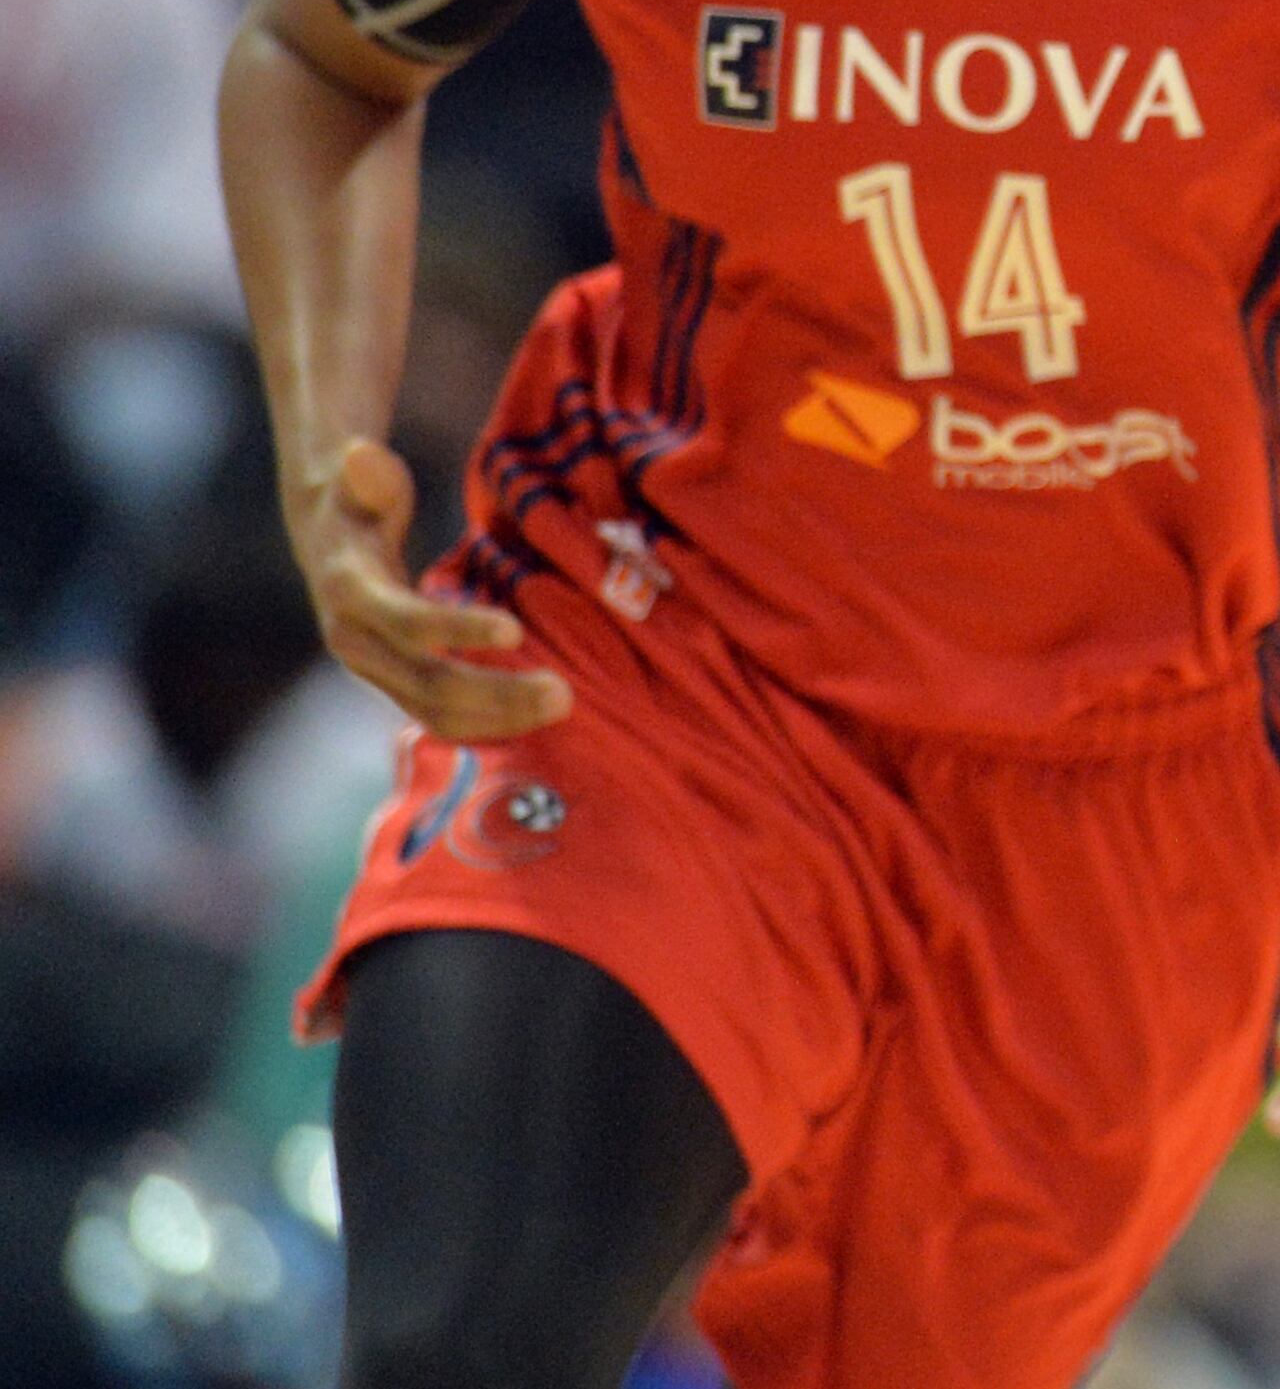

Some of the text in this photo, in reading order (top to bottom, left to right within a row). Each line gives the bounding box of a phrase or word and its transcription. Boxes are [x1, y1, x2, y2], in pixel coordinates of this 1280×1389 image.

[792, 23, 1205, 143] INOVA
[838, 160, 1087, 384] 14
[932, 394, 1200, 483] boost
